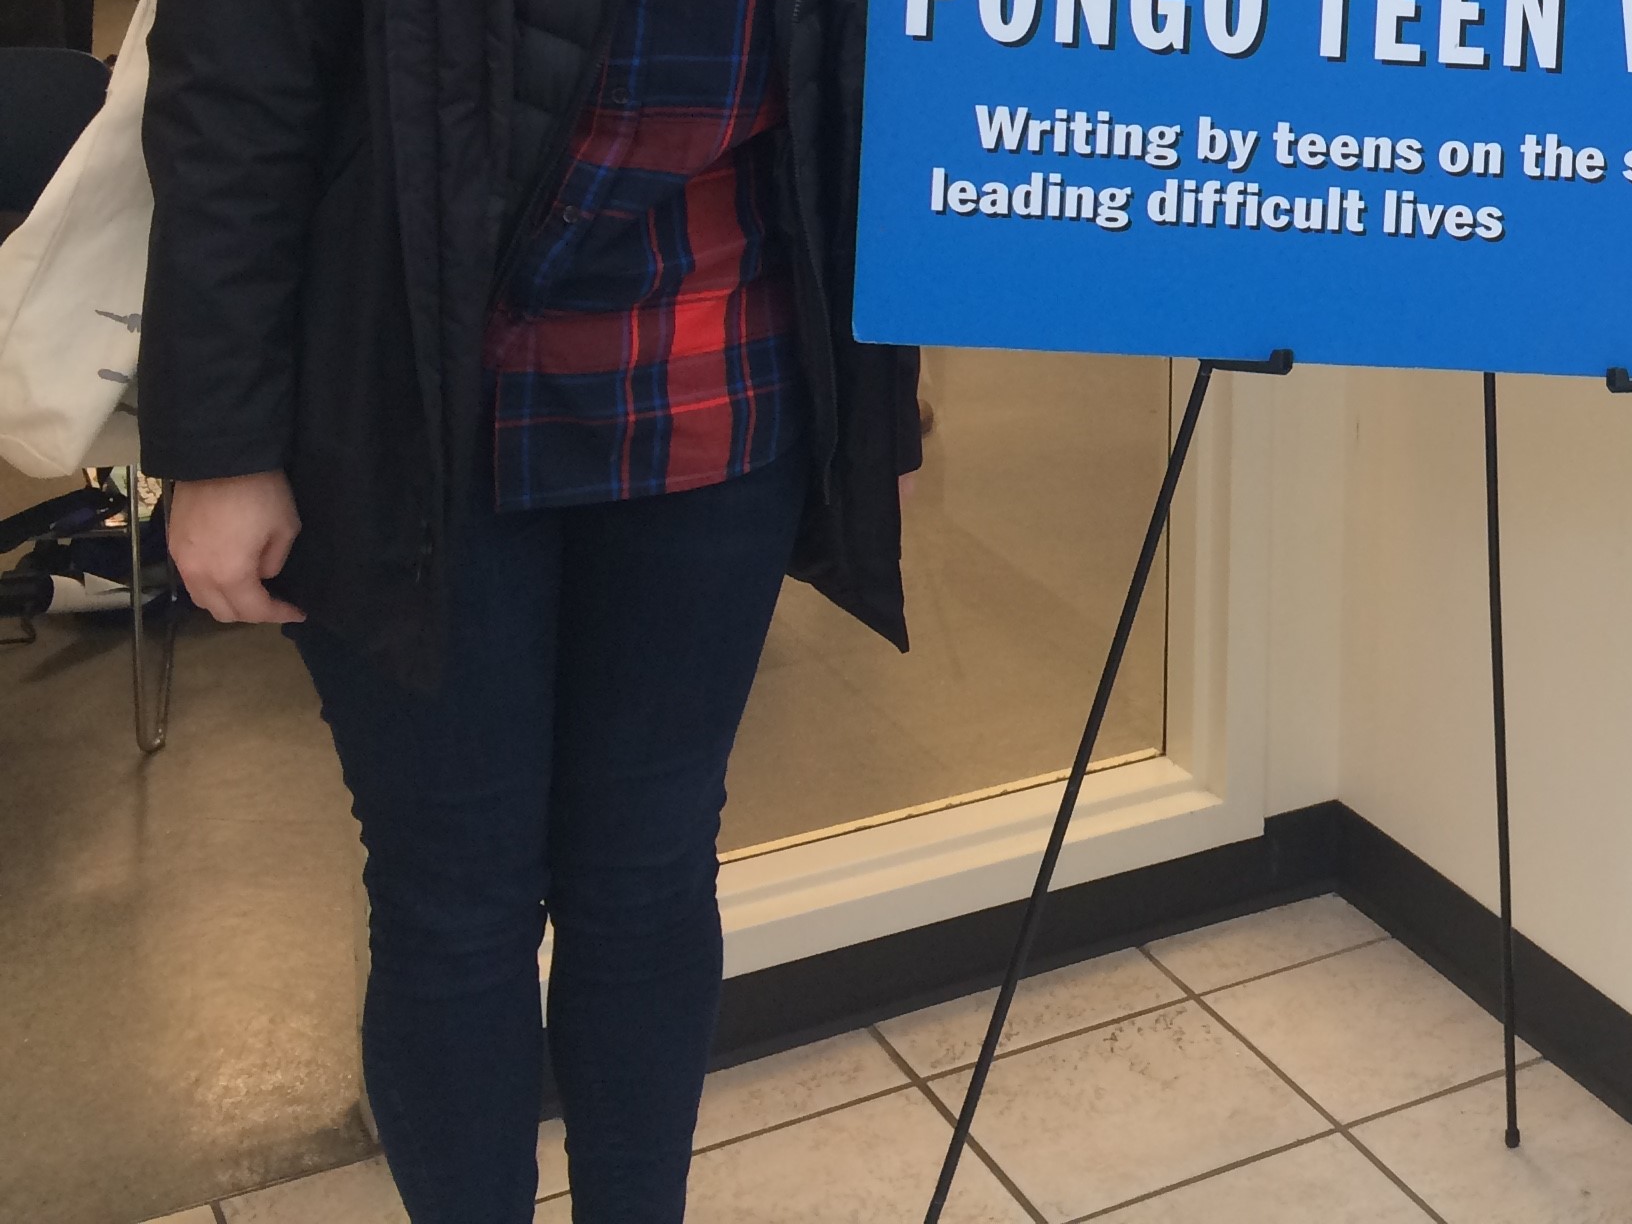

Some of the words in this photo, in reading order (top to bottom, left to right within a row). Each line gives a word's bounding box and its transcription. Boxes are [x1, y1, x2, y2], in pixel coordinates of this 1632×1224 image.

[975, 104, 1182, 167] Writing
[1197, 116, 1259, 171] by
[1272, 121, 1423, 172] teens
[1438, 140, 1503, 176] on
[1520, 133, 1606, 181] the
[931, 167, 1133, 229] leading
[1147, 178, 1366, 233] difficult
[1383, 189, 1504, 240] lives
